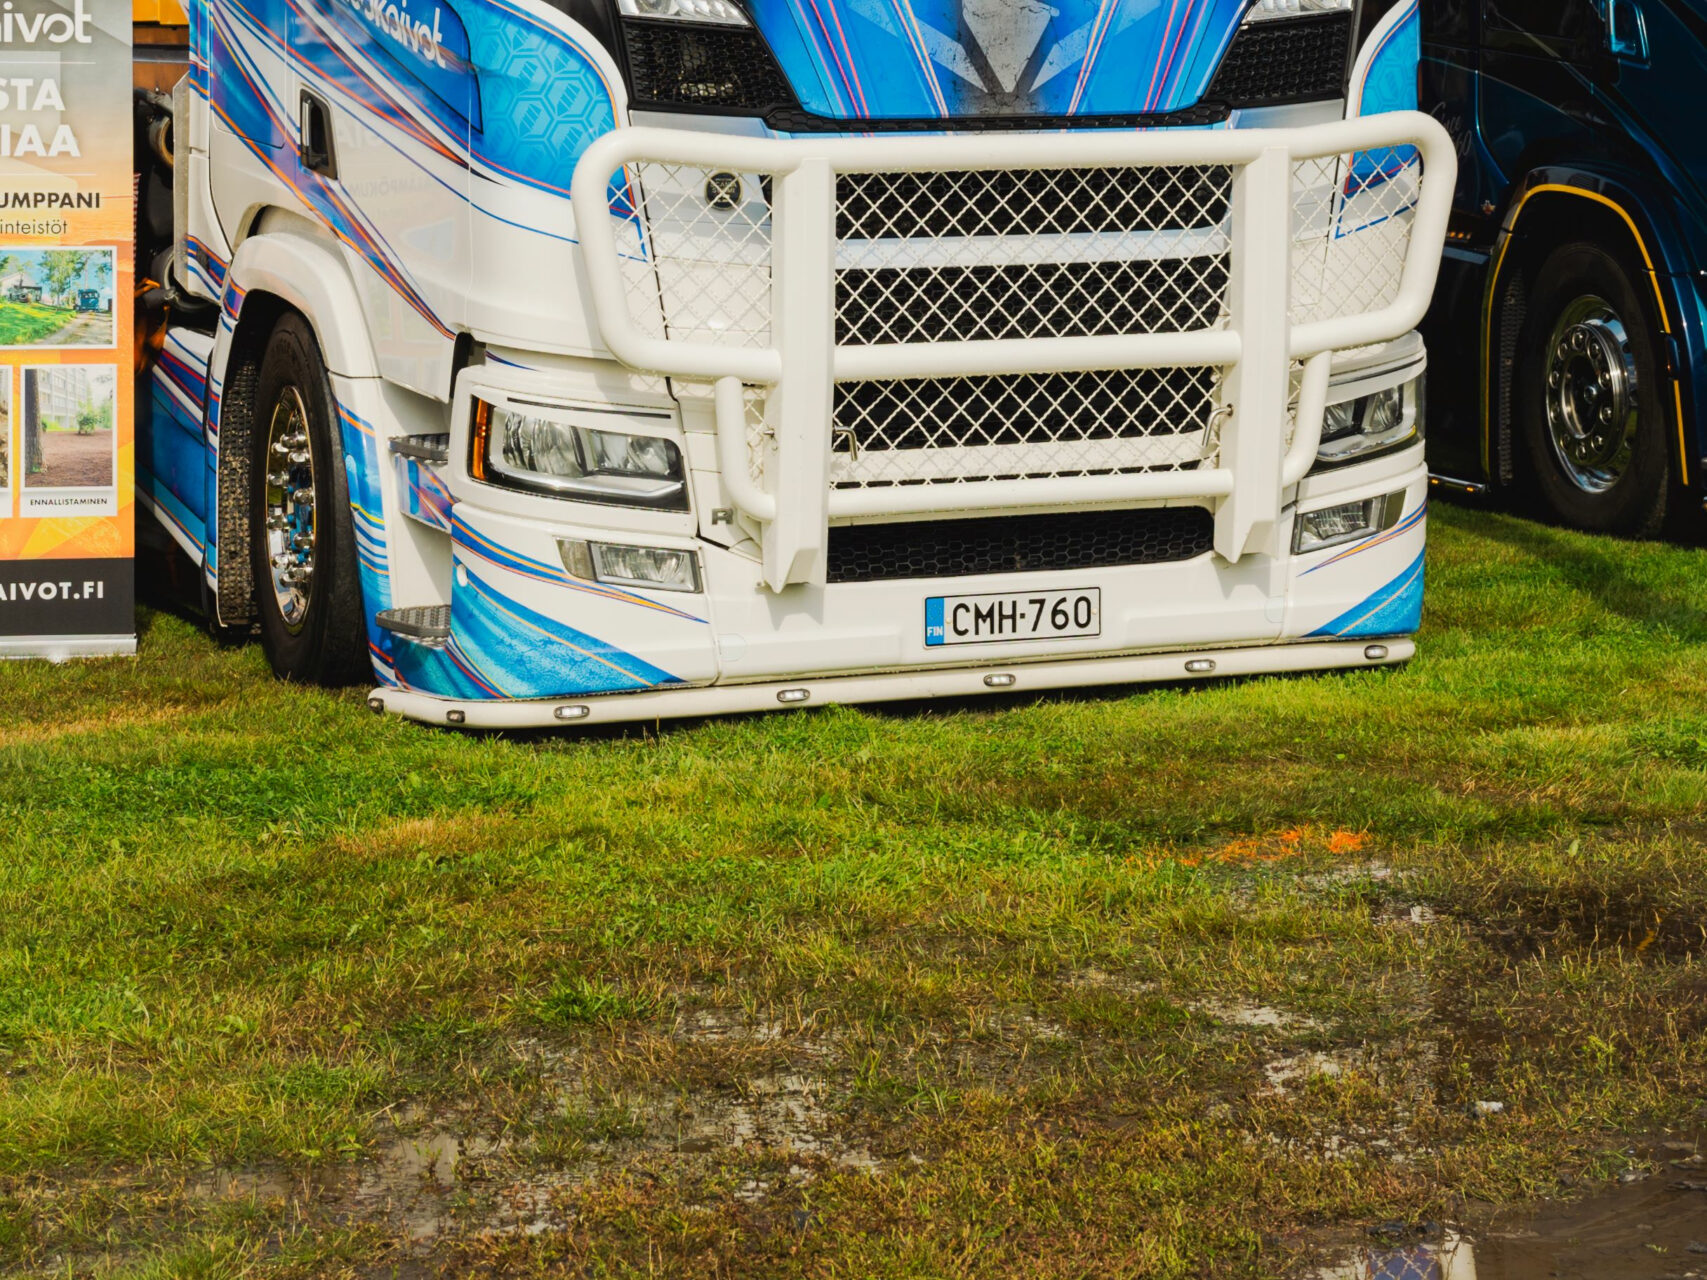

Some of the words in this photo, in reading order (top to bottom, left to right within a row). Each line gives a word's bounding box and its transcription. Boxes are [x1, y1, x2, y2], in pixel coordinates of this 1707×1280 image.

[30, 498, 108, 506] ENNALLISTAMINEN
[952, 595, 1092, 637] CMH-760
[927, 625, 943, 637] FIN
